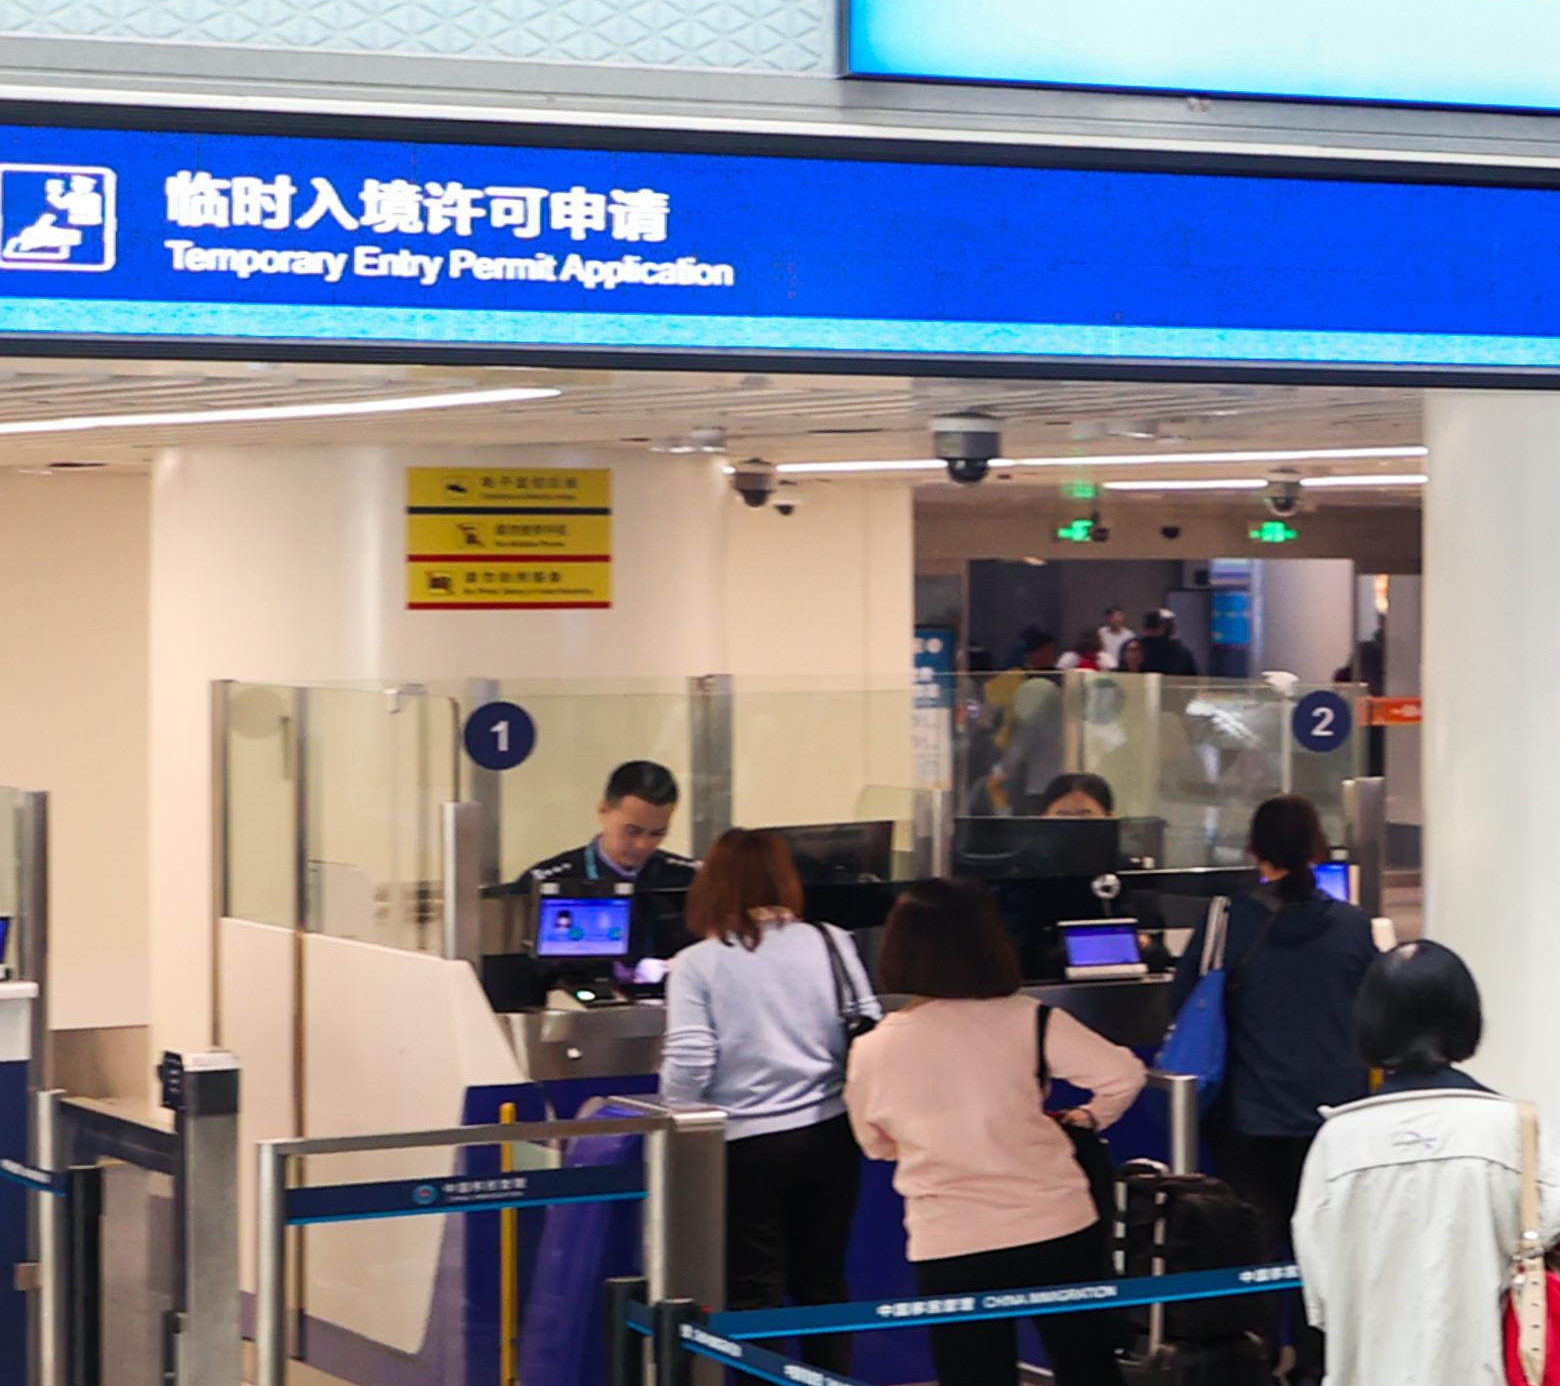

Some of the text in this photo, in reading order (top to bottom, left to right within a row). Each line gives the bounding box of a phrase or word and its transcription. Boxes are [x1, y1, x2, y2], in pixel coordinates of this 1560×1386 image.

[165, 170, 671, 243] 临时入境许可申请
[165, 241, 734, 291] Temporary Entry Permit Application
[489, 721, 510, 752] 1
[1311, 706, 1337, 737] 2
